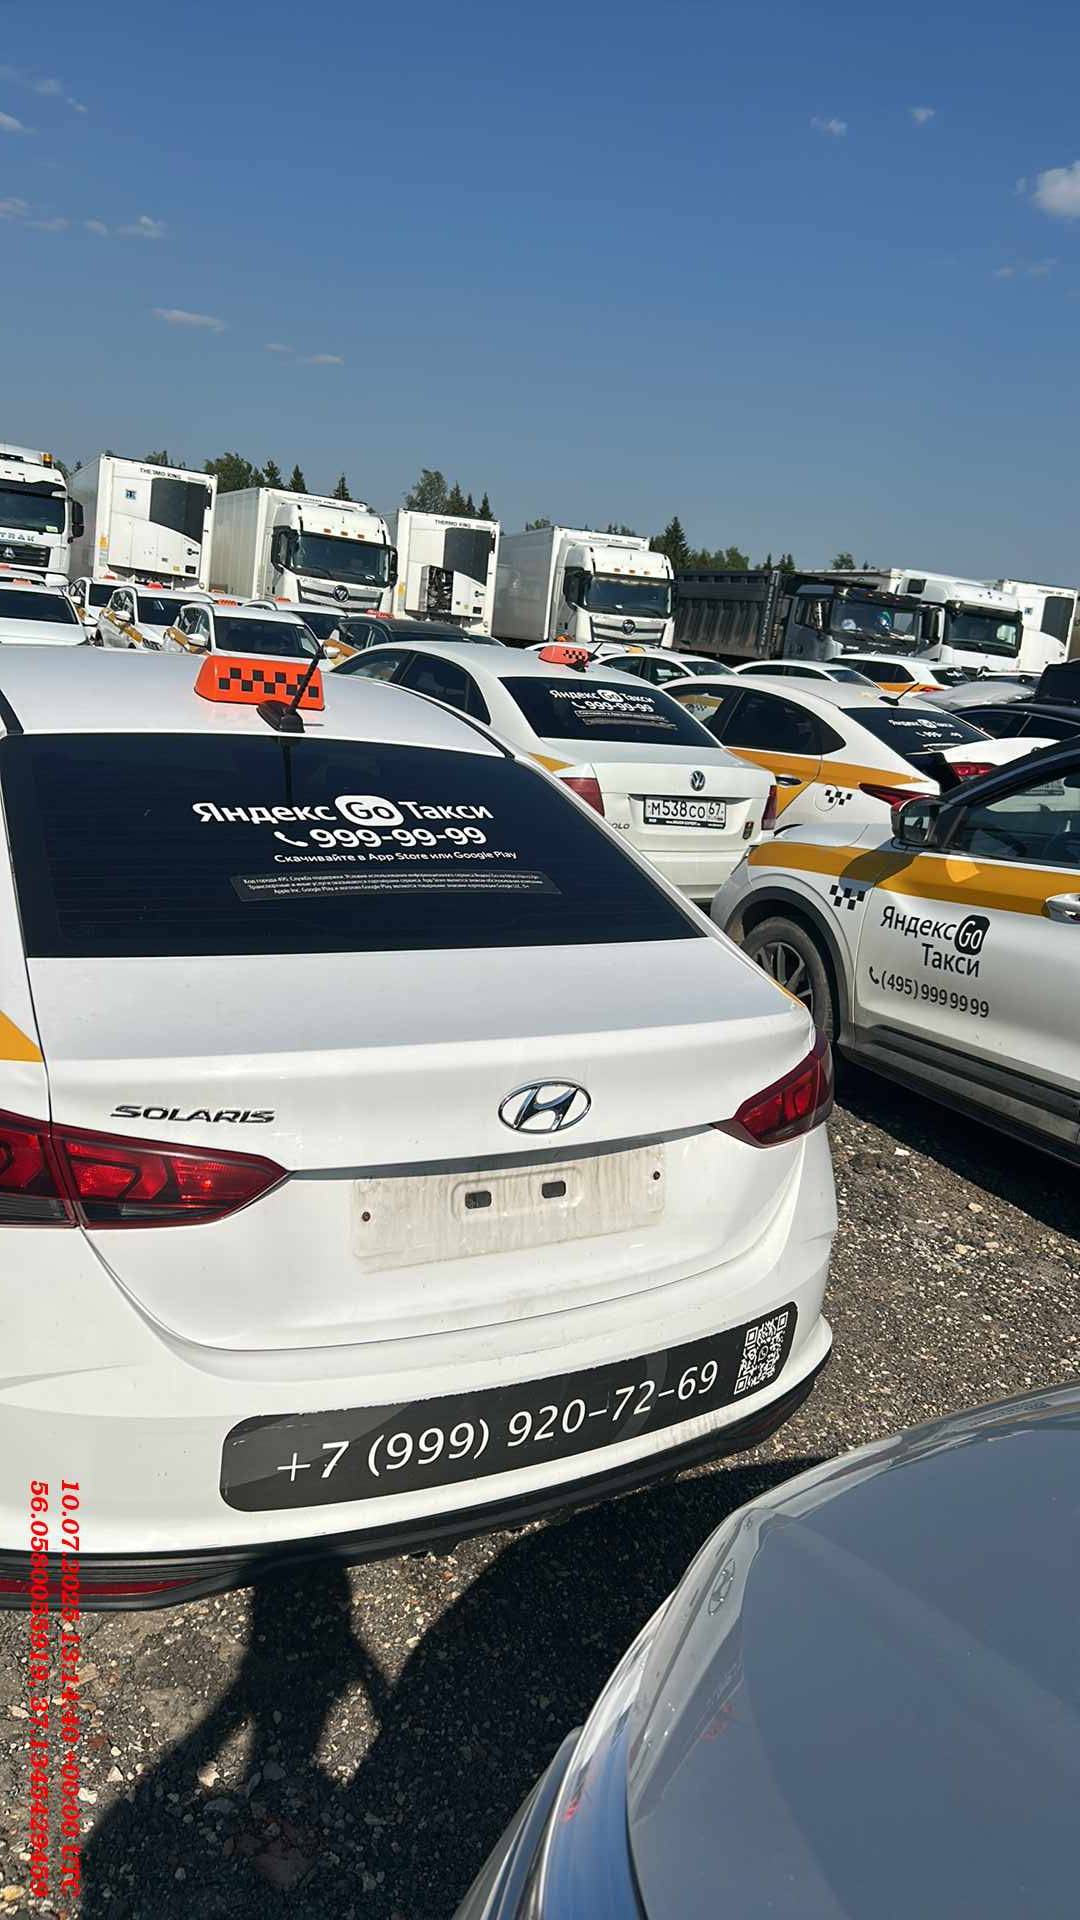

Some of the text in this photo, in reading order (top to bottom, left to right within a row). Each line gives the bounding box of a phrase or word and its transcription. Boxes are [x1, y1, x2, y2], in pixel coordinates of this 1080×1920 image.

[584, 700, 655, 713] 999-99-99
[192, 800, 495, 825] Яндекс Go Такси
[309, 826, 488, 848] 999-99-99
[611, 822, 630, 830] OLO
[274, 853, 356, 863] Скачивайте
[357, 854, 367, 862] в
[368, 852, 394, 862] App
[395, 852, 429, 861] Store
[454, 851, 494, 861] Google
[494, 851, 517, 860] Play
[880, 905, 986, 952] Яндекс Go
[921, 942, 980, 978] Такси
[110, 1104, 275, 1124] SOLARIS
[276, 1360, 719, 1483] +7 (999) 920-72-69
